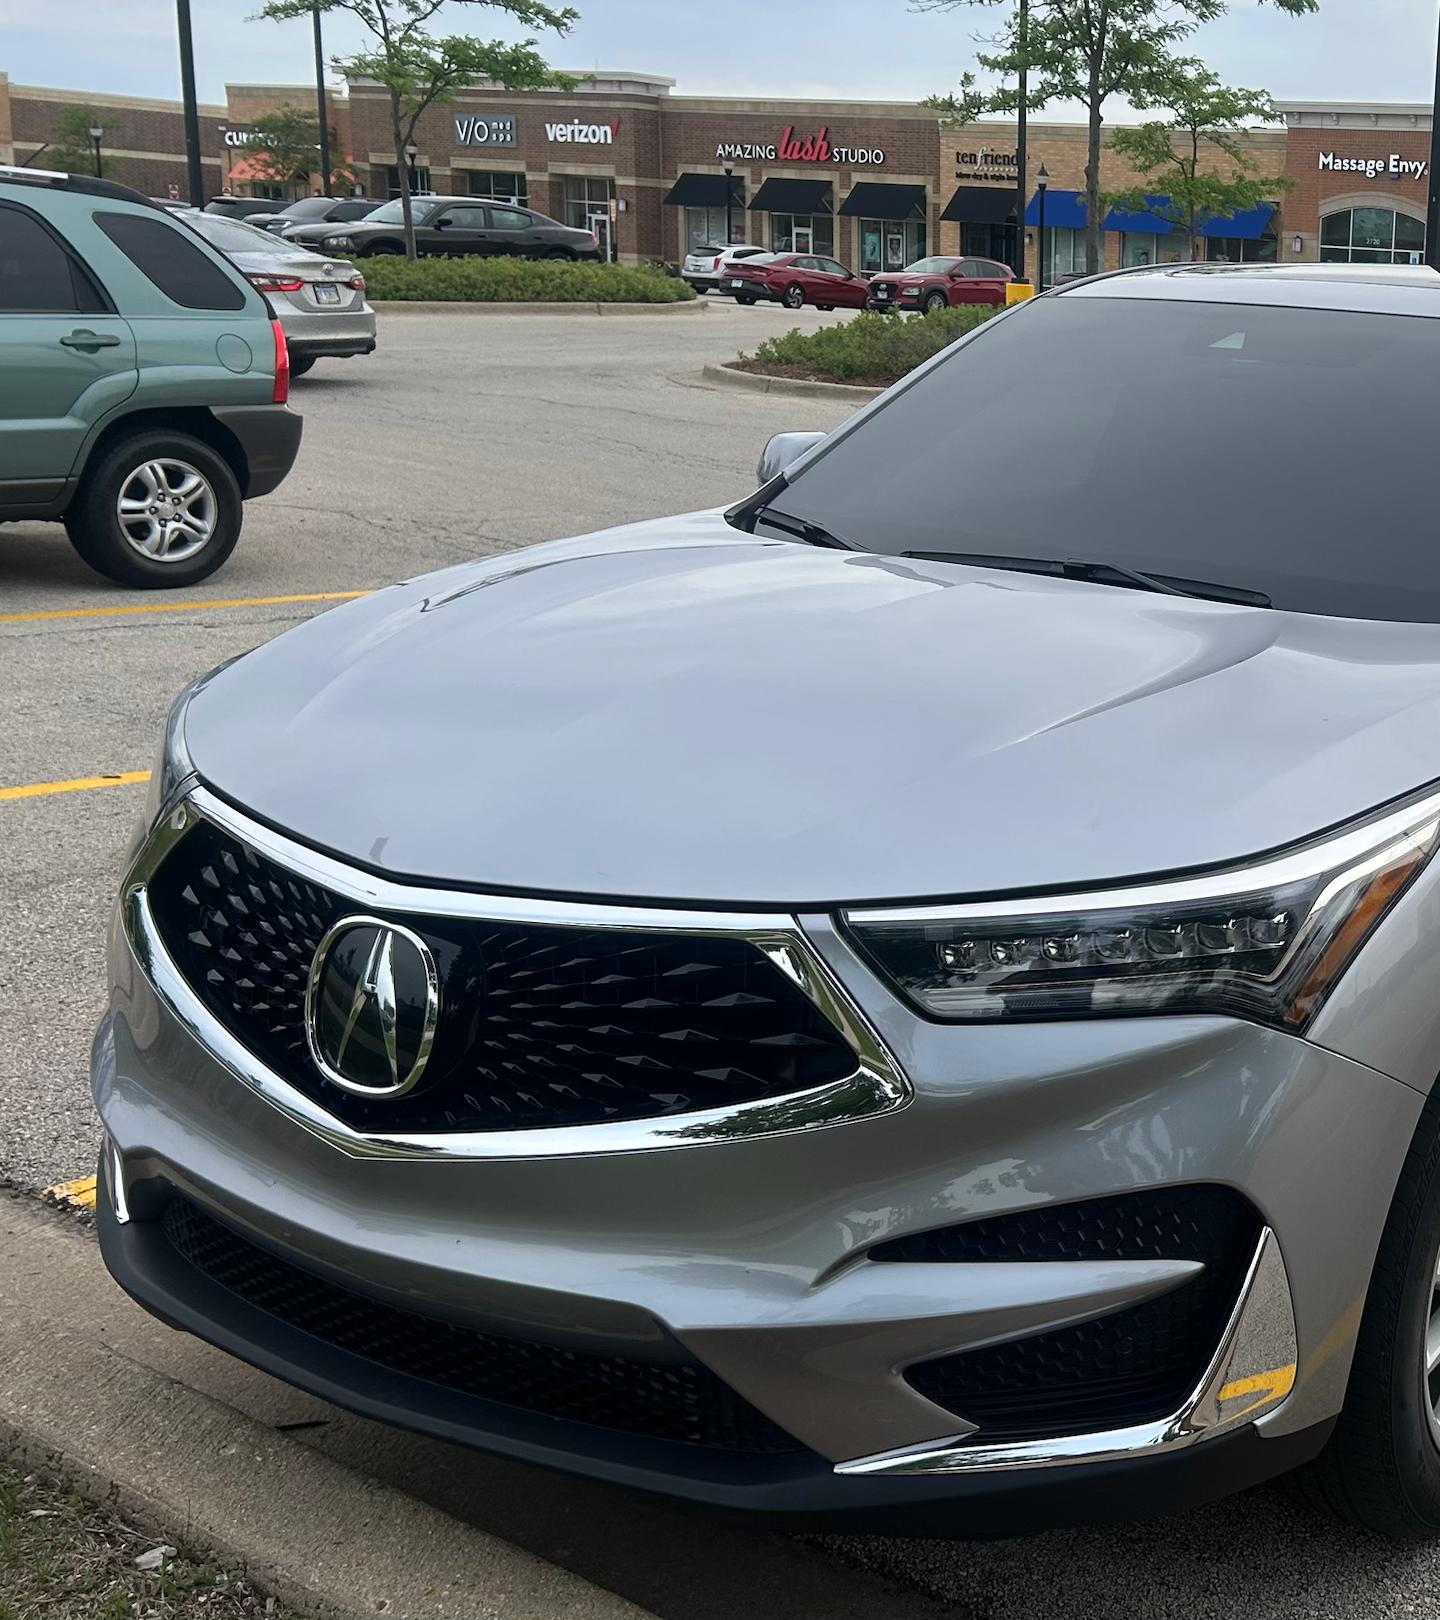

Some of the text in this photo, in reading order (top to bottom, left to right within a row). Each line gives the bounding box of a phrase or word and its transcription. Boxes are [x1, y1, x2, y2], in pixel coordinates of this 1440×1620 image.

[456, 117, 489, 145] V/O
[492, 121, 511, 130] med
[492, 133, 511, 142] spa
[545, 119, 612, 144] verizon
[716, 126, 884, 164] AMAZING lash STUDIO
[955, 147, 1029, 169] tenfriend
[1318, 151, 1427, 180] Massage Envy
